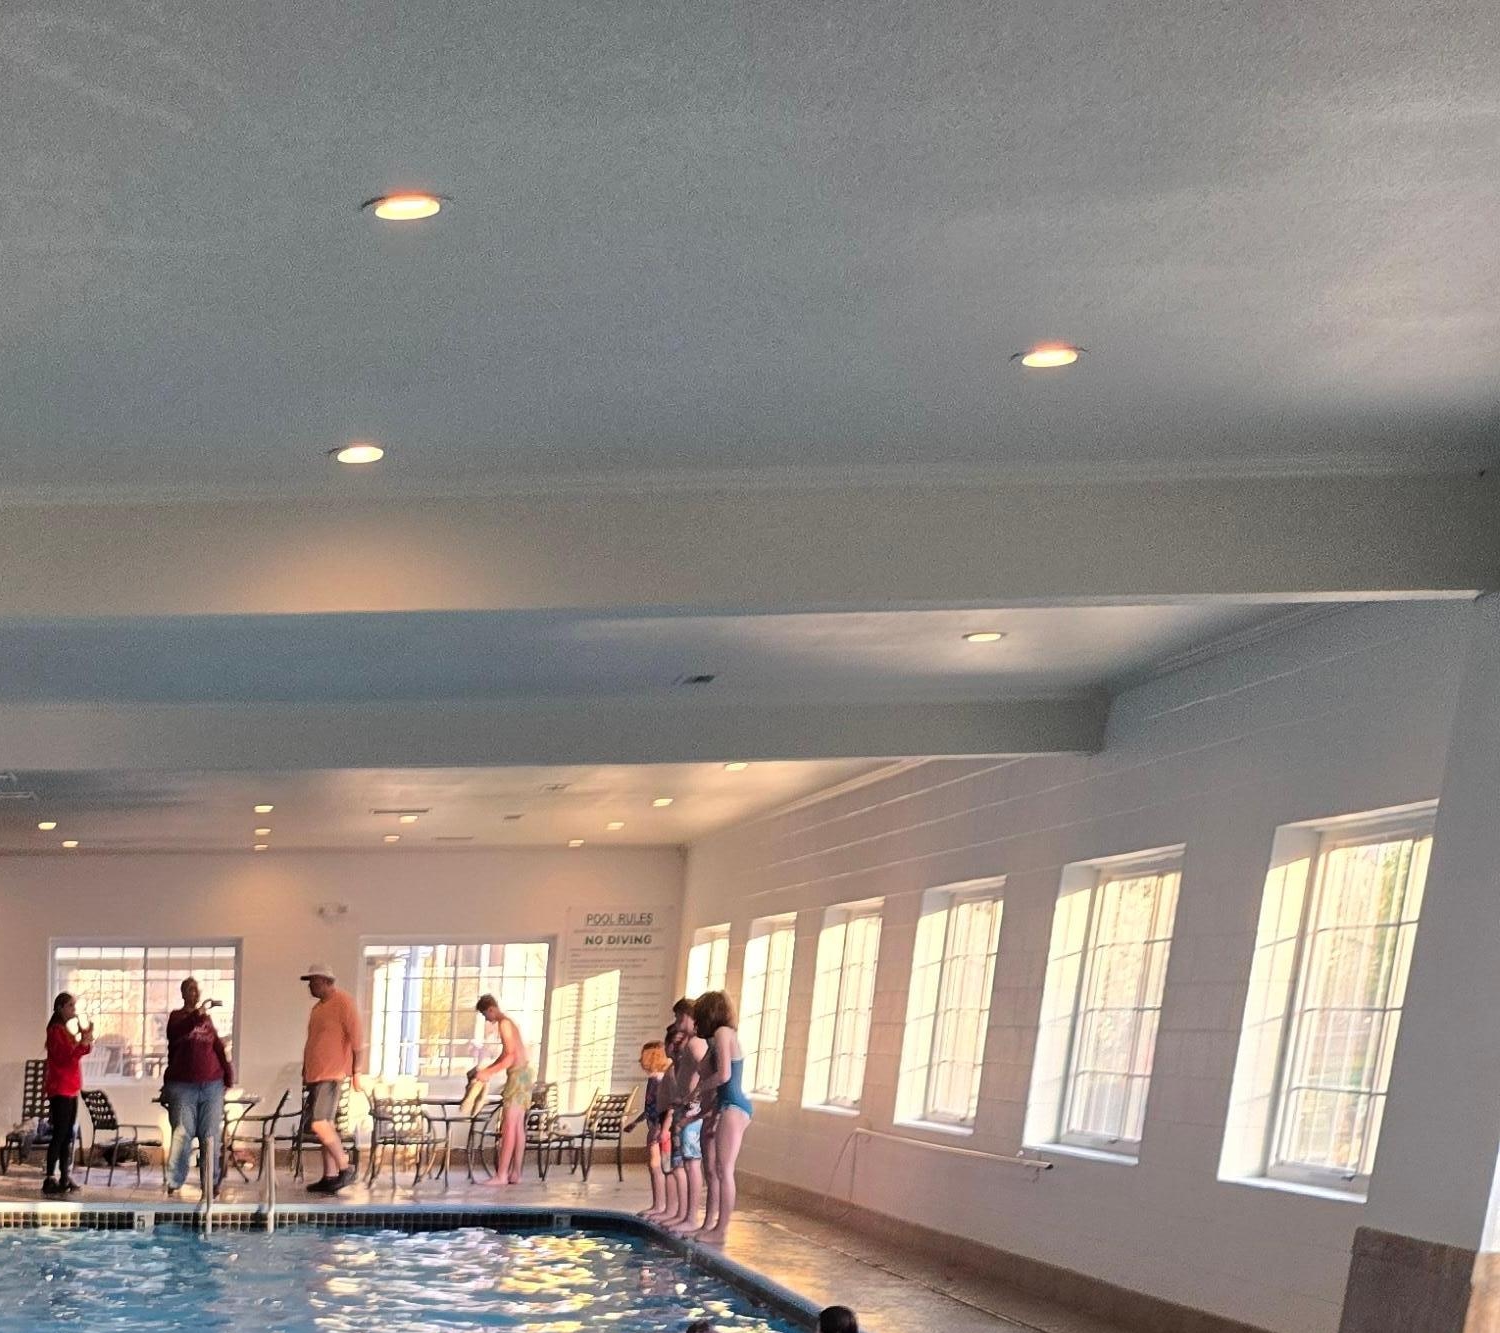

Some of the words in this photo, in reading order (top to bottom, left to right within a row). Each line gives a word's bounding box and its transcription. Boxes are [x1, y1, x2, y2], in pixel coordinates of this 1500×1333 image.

[586, 912, 615, 926] POOL
[618, 912, 654, 926] RULES
[585, 935, 603, 945] NO
[607, 934, 652, 945] DIVING
